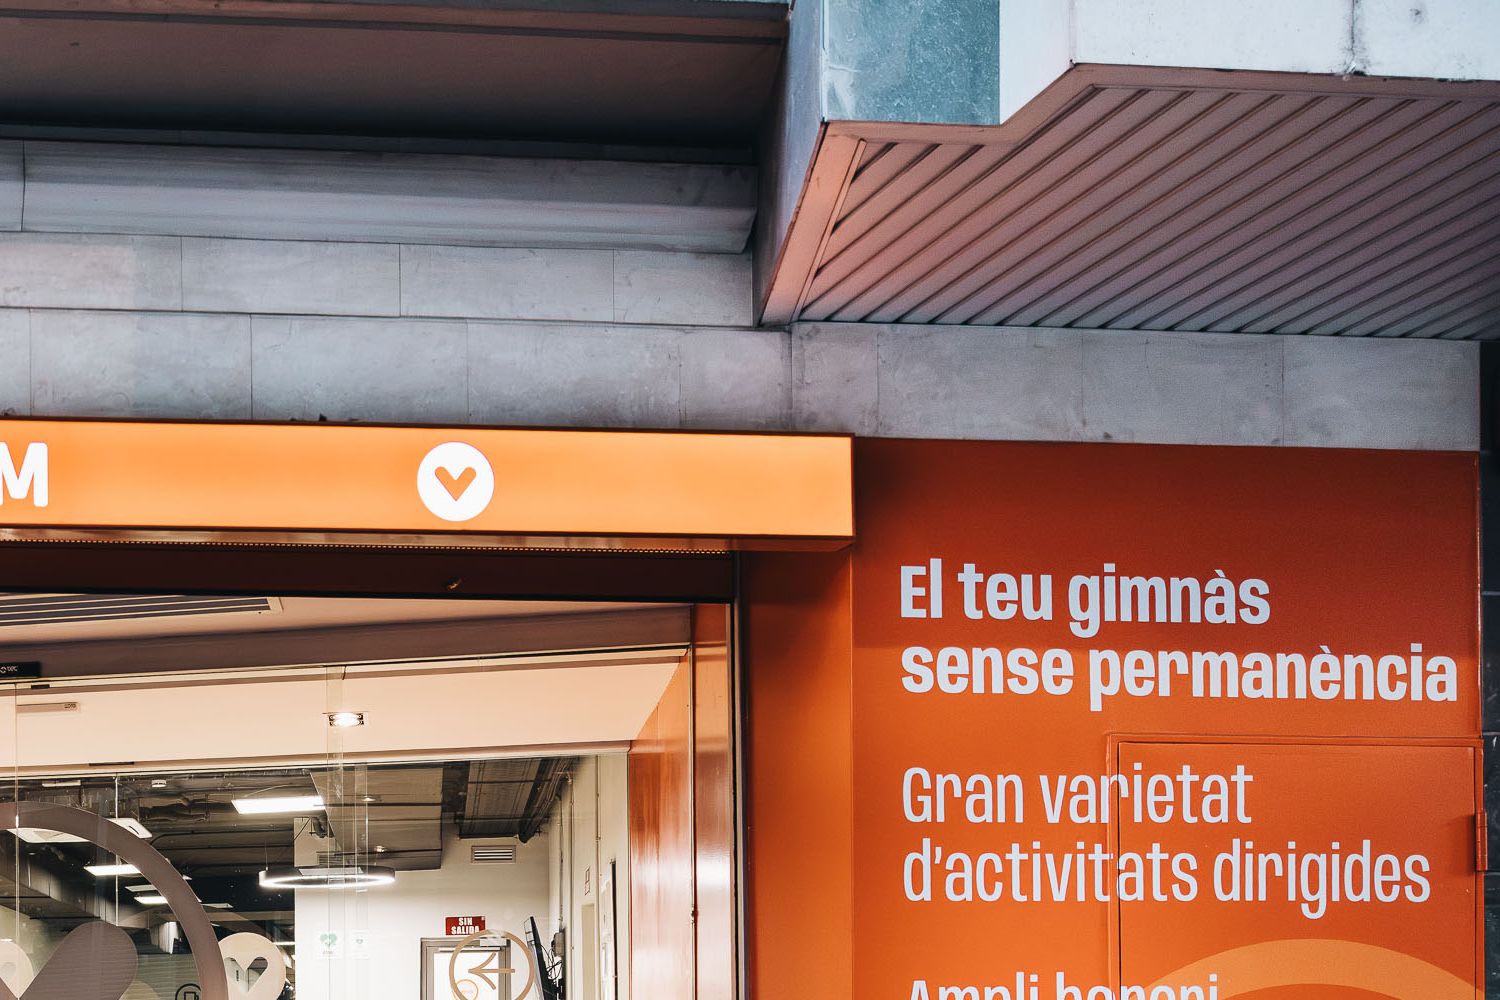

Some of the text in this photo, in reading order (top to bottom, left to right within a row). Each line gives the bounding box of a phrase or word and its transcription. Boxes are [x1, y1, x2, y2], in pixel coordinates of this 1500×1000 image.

[900, 558, 1271, 638] El teu gimnàs
[901, 643, 1458, 712] sense permanència
[902, 762, 1254, 824] Gran varietat
[903, 837, 1431, 920] d'activitats dirigides
[451, 926, 480, 935] SALIDA
[458, 917, 473, 926] SIN
